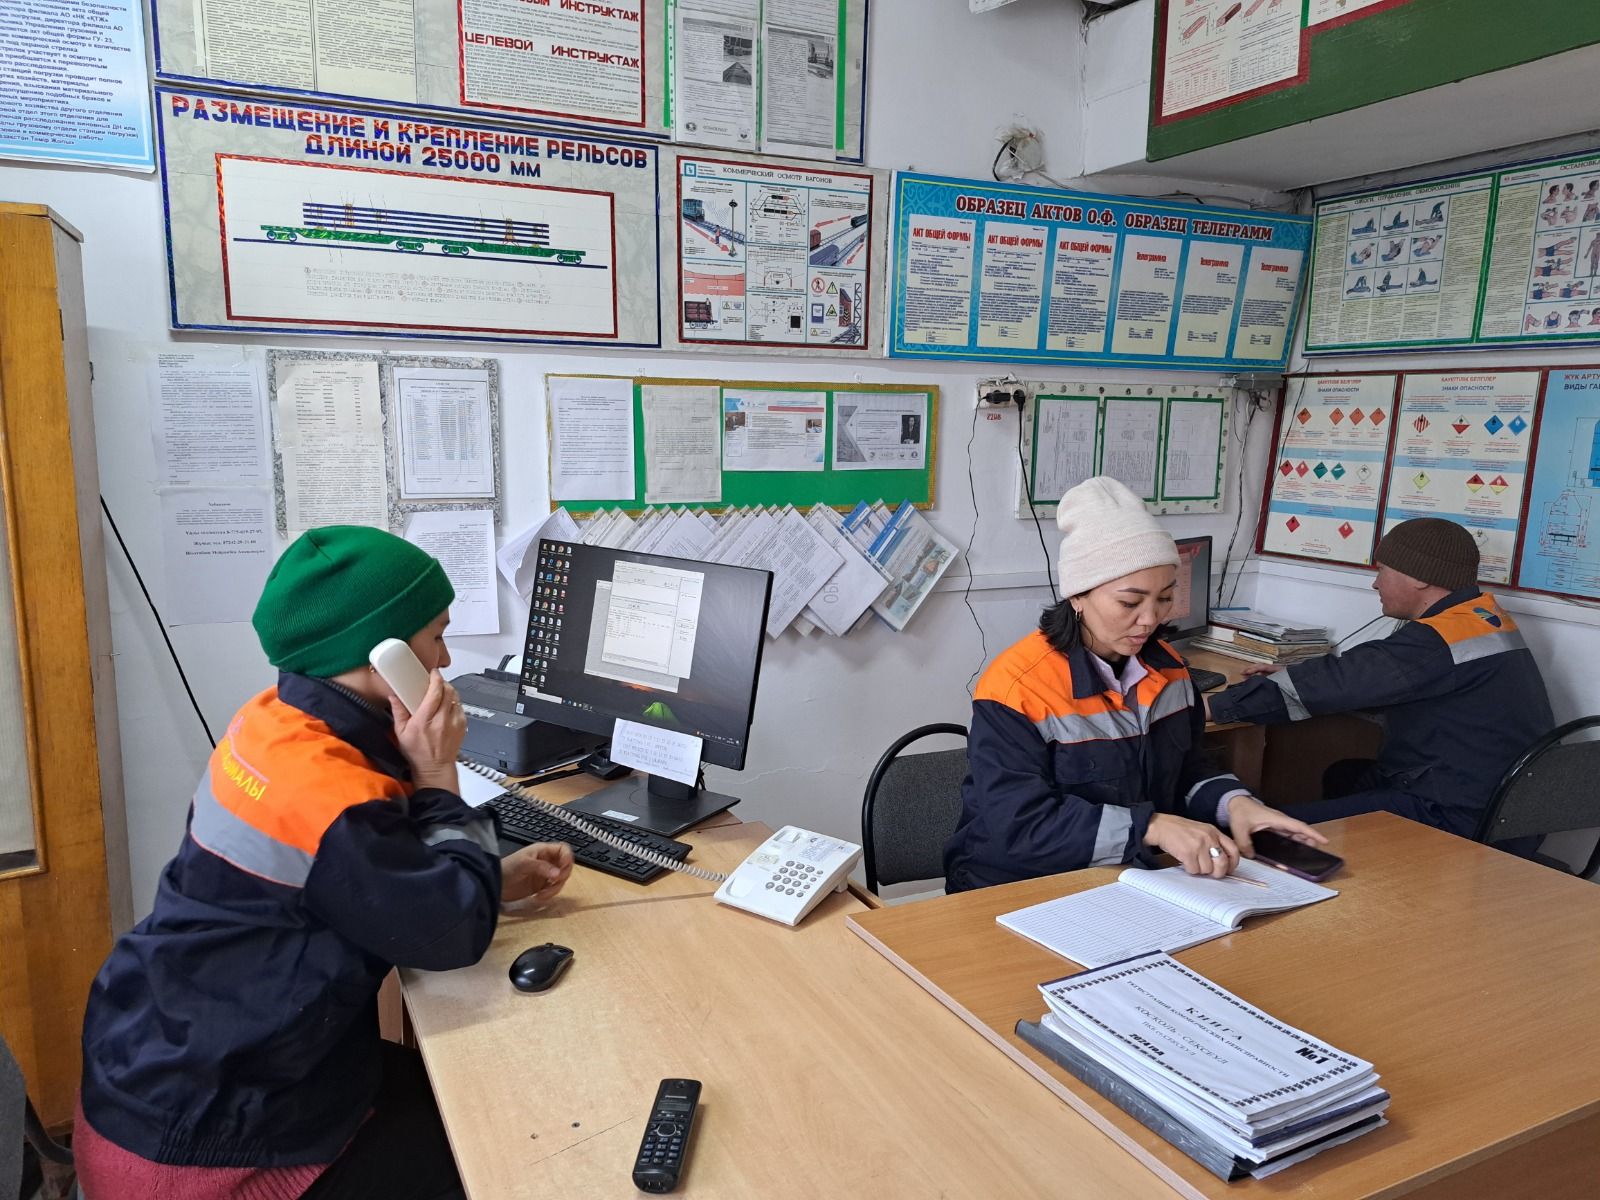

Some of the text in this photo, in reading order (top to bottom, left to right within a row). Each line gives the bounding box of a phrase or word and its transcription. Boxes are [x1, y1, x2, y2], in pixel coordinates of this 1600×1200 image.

[560, 0, 639, 22] ИНСТРУКТАЖ
[82, 22, 111, 30] филиала
[67, 33, 91, 41] формы
[465, 32, 639, 68] ЦЕЛЕВОЙ ИНСТРУКТАЖ
[172, 94, 648, 168] РАЗМЕЩЕНИЕ И КРЕПЛЕНИЕ РЕЛЬСОВ
[305, 134, 411, 165] ДЛИНОЙ
[422, 147, 501, 174] 25000
[722, 167, 774, 178] КОММЕРЧЕСКИЙ
[778, 173, 802, 181] ОСМОТР
[805, 175, 833, 184] ВАГОНОВ
[956, 196, 1272, 241] ОБРАЗЕЦ АКТОВ О.Ф. ОБРАЗЕЦ ТЕЛЕГРАММ
[913, 228, 971, 242] АКТ ОБЩЕЙ ФОРМЫ
[988, 234, 1043, 248] АКТ ОБЩЕЙ ФОРМЫ
[1059, 241, 1112, 254] АКТ ОБЩЕЙ ФОРМЫ
[1136, 251, 1167, 263] Телеграмма
[1564, 383, 1587, 391] ВИДЫ
[1128, 1033, 1151, 1050] 2024
[1295, 1047, 1329, 1064] №1
